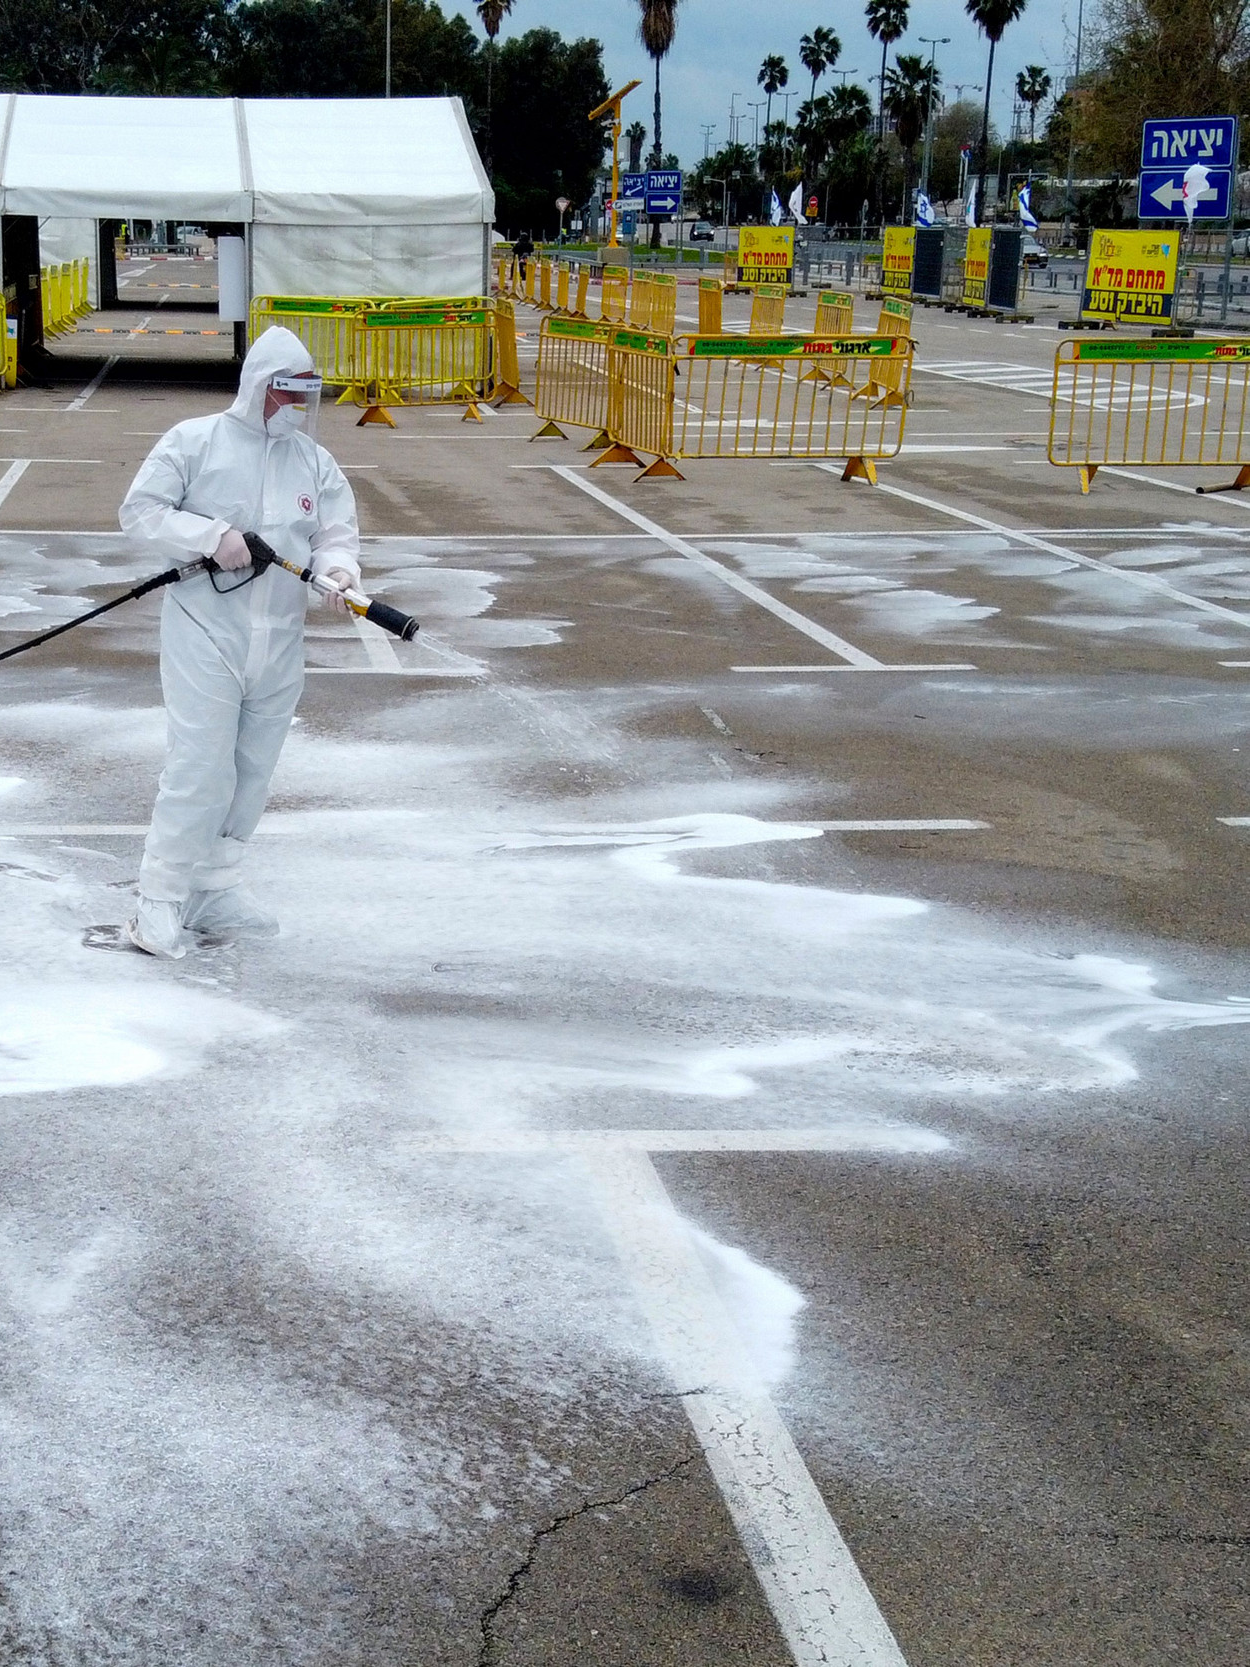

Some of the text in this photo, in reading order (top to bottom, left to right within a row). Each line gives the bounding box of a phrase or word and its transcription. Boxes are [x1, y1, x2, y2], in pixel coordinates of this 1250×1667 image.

[1152, 129, 1223, 158] יציאה
[650, 175, 678, 188] יציאה
[764, 252, 788, 266] מתחם
[742, 267, 787, 283] היבדק וסע
[1126, 269, 1166, 290] מתחם
[1089, 291, 1163, 319] היבדק וסע
[803, 342, 833, 354] במות
[835, 342, 871, 354] ארגוני
